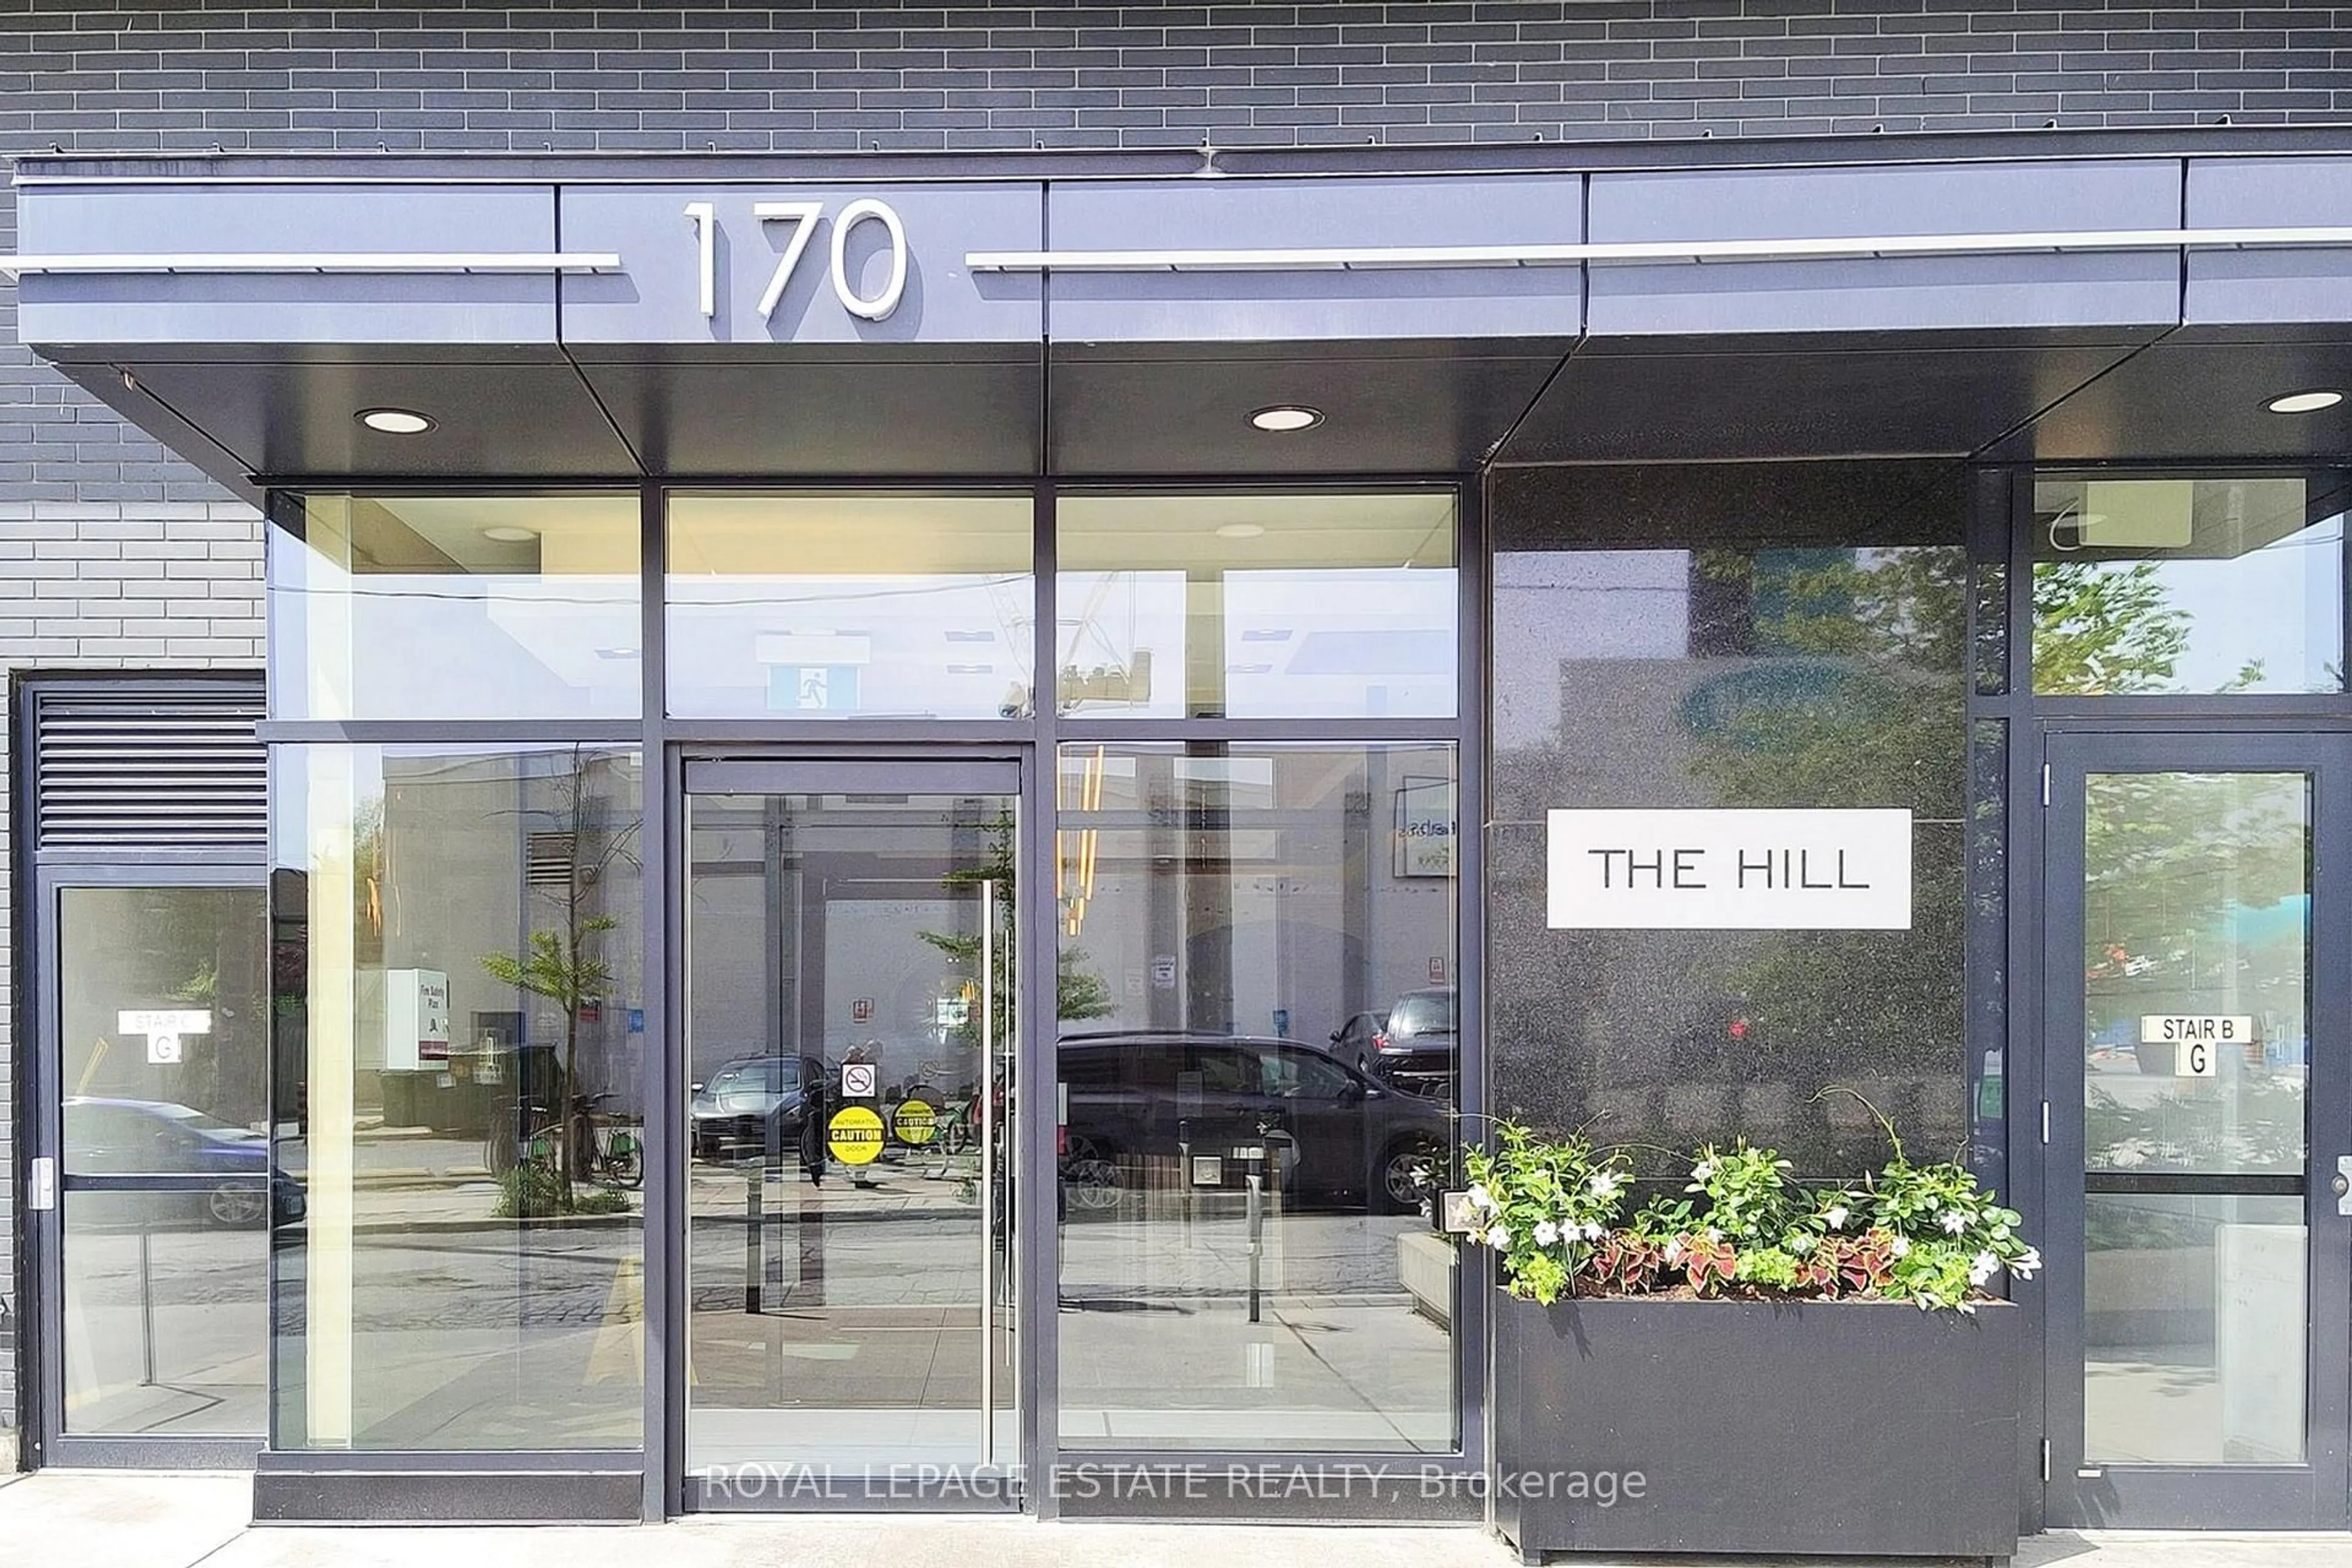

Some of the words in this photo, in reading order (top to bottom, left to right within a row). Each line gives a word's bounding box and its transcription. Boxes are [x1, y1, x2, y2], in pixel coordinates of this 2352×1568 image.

[683, 198, 907, 321] 170
[1588, 849, 1706, 889] THE
[1738, 849, 1870, 889] HILL
[2163, 1019, 2215, 1039] STAIR
[2222, 1019, 2234, 1039] B
[156, 1036, 172, 1059] G
[2190, 1044, 2206, 1073] G
[831, 1129, 881, 1140] CAUTION
